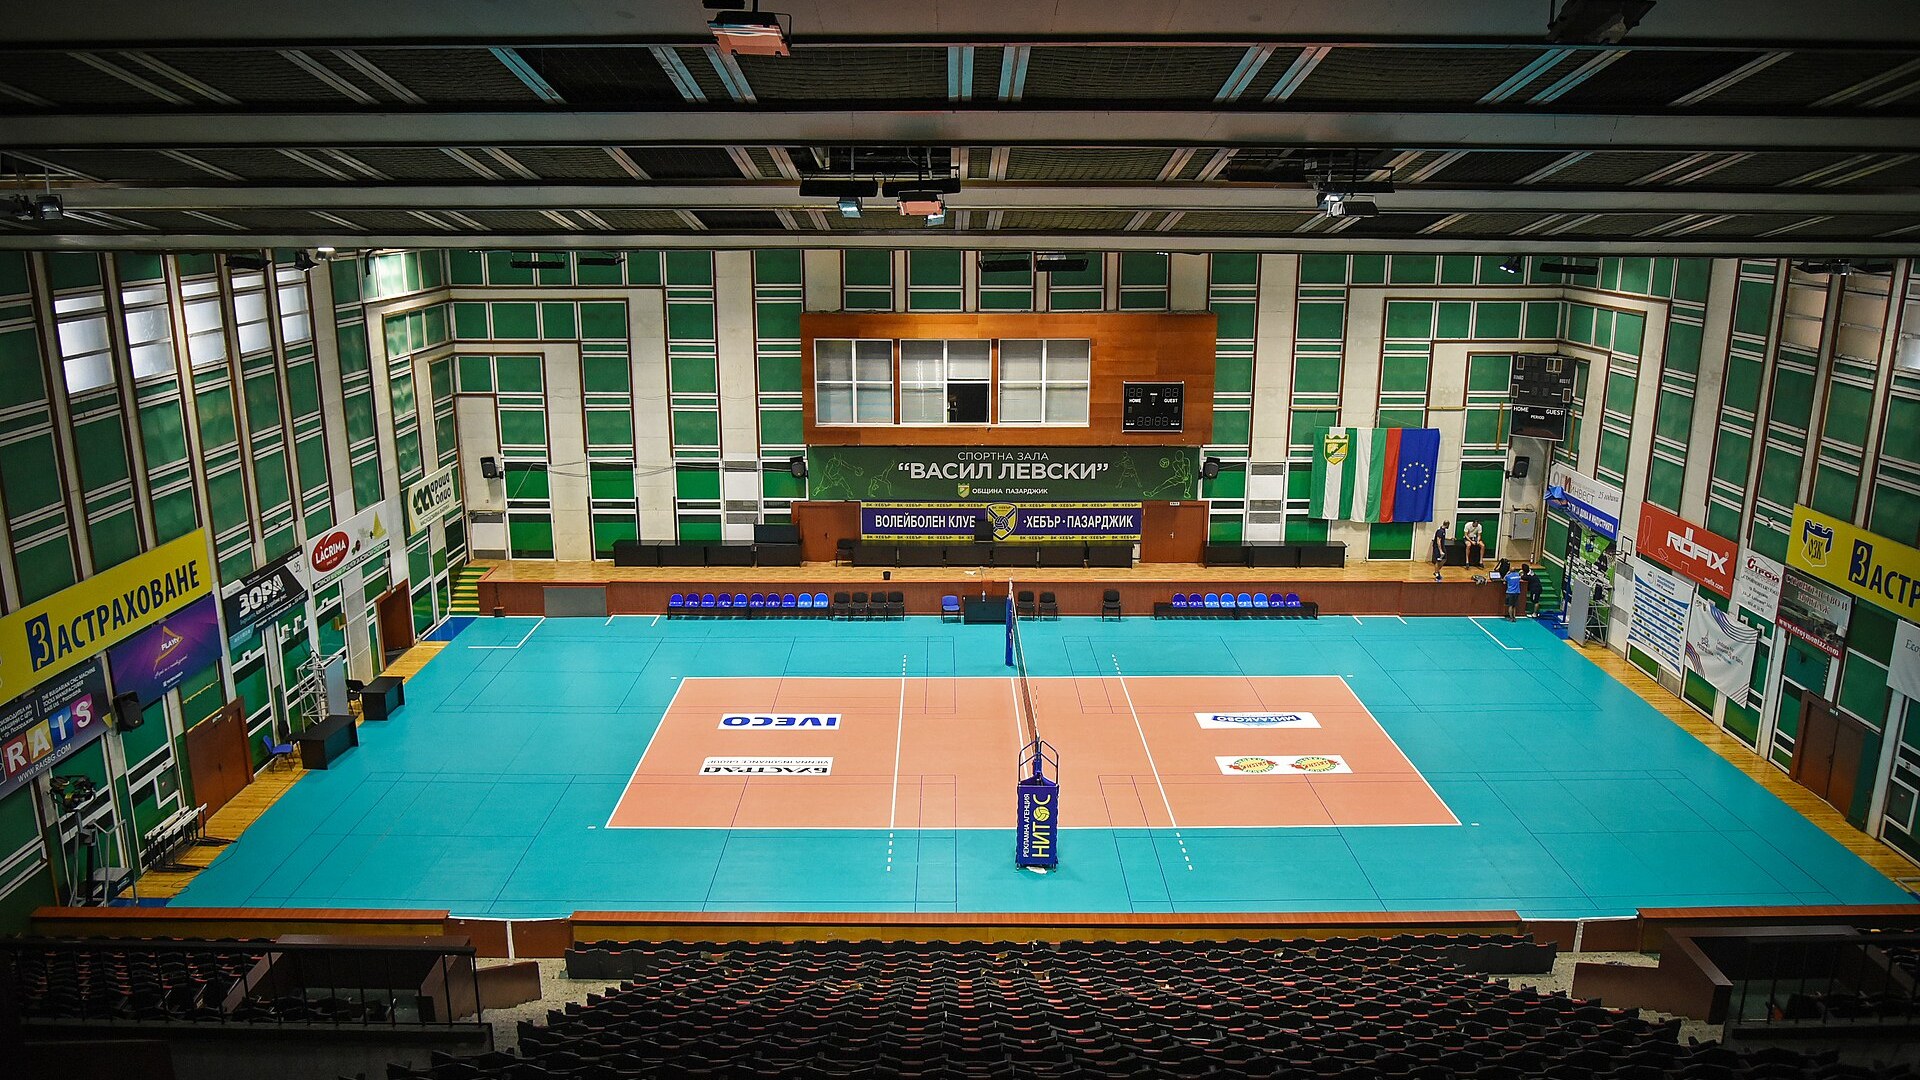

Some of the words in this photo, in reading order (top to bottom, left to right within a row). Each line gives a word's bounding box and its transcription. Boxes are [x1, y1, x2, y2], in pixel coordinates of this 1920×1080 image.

[958, 452, 1014, 461] СПОРТНА
[1017, 452, 1050, 461] ЗАЛА
[876, 512, 946, 528] ВОЛЕЙБОЛЕН
[1067, 516, 1133, 530] ПАЗАРДЖИК
[32, 560, 200, 669] ЗАСТРАХОВАНЕ
[239, 574, 284, 618] ЗОРА
[6, 701, 92, 773] RAIS
[722, 716, 837, 727] IVECO
[18, 744, 71, 782] WWW.RAISBG.COM
